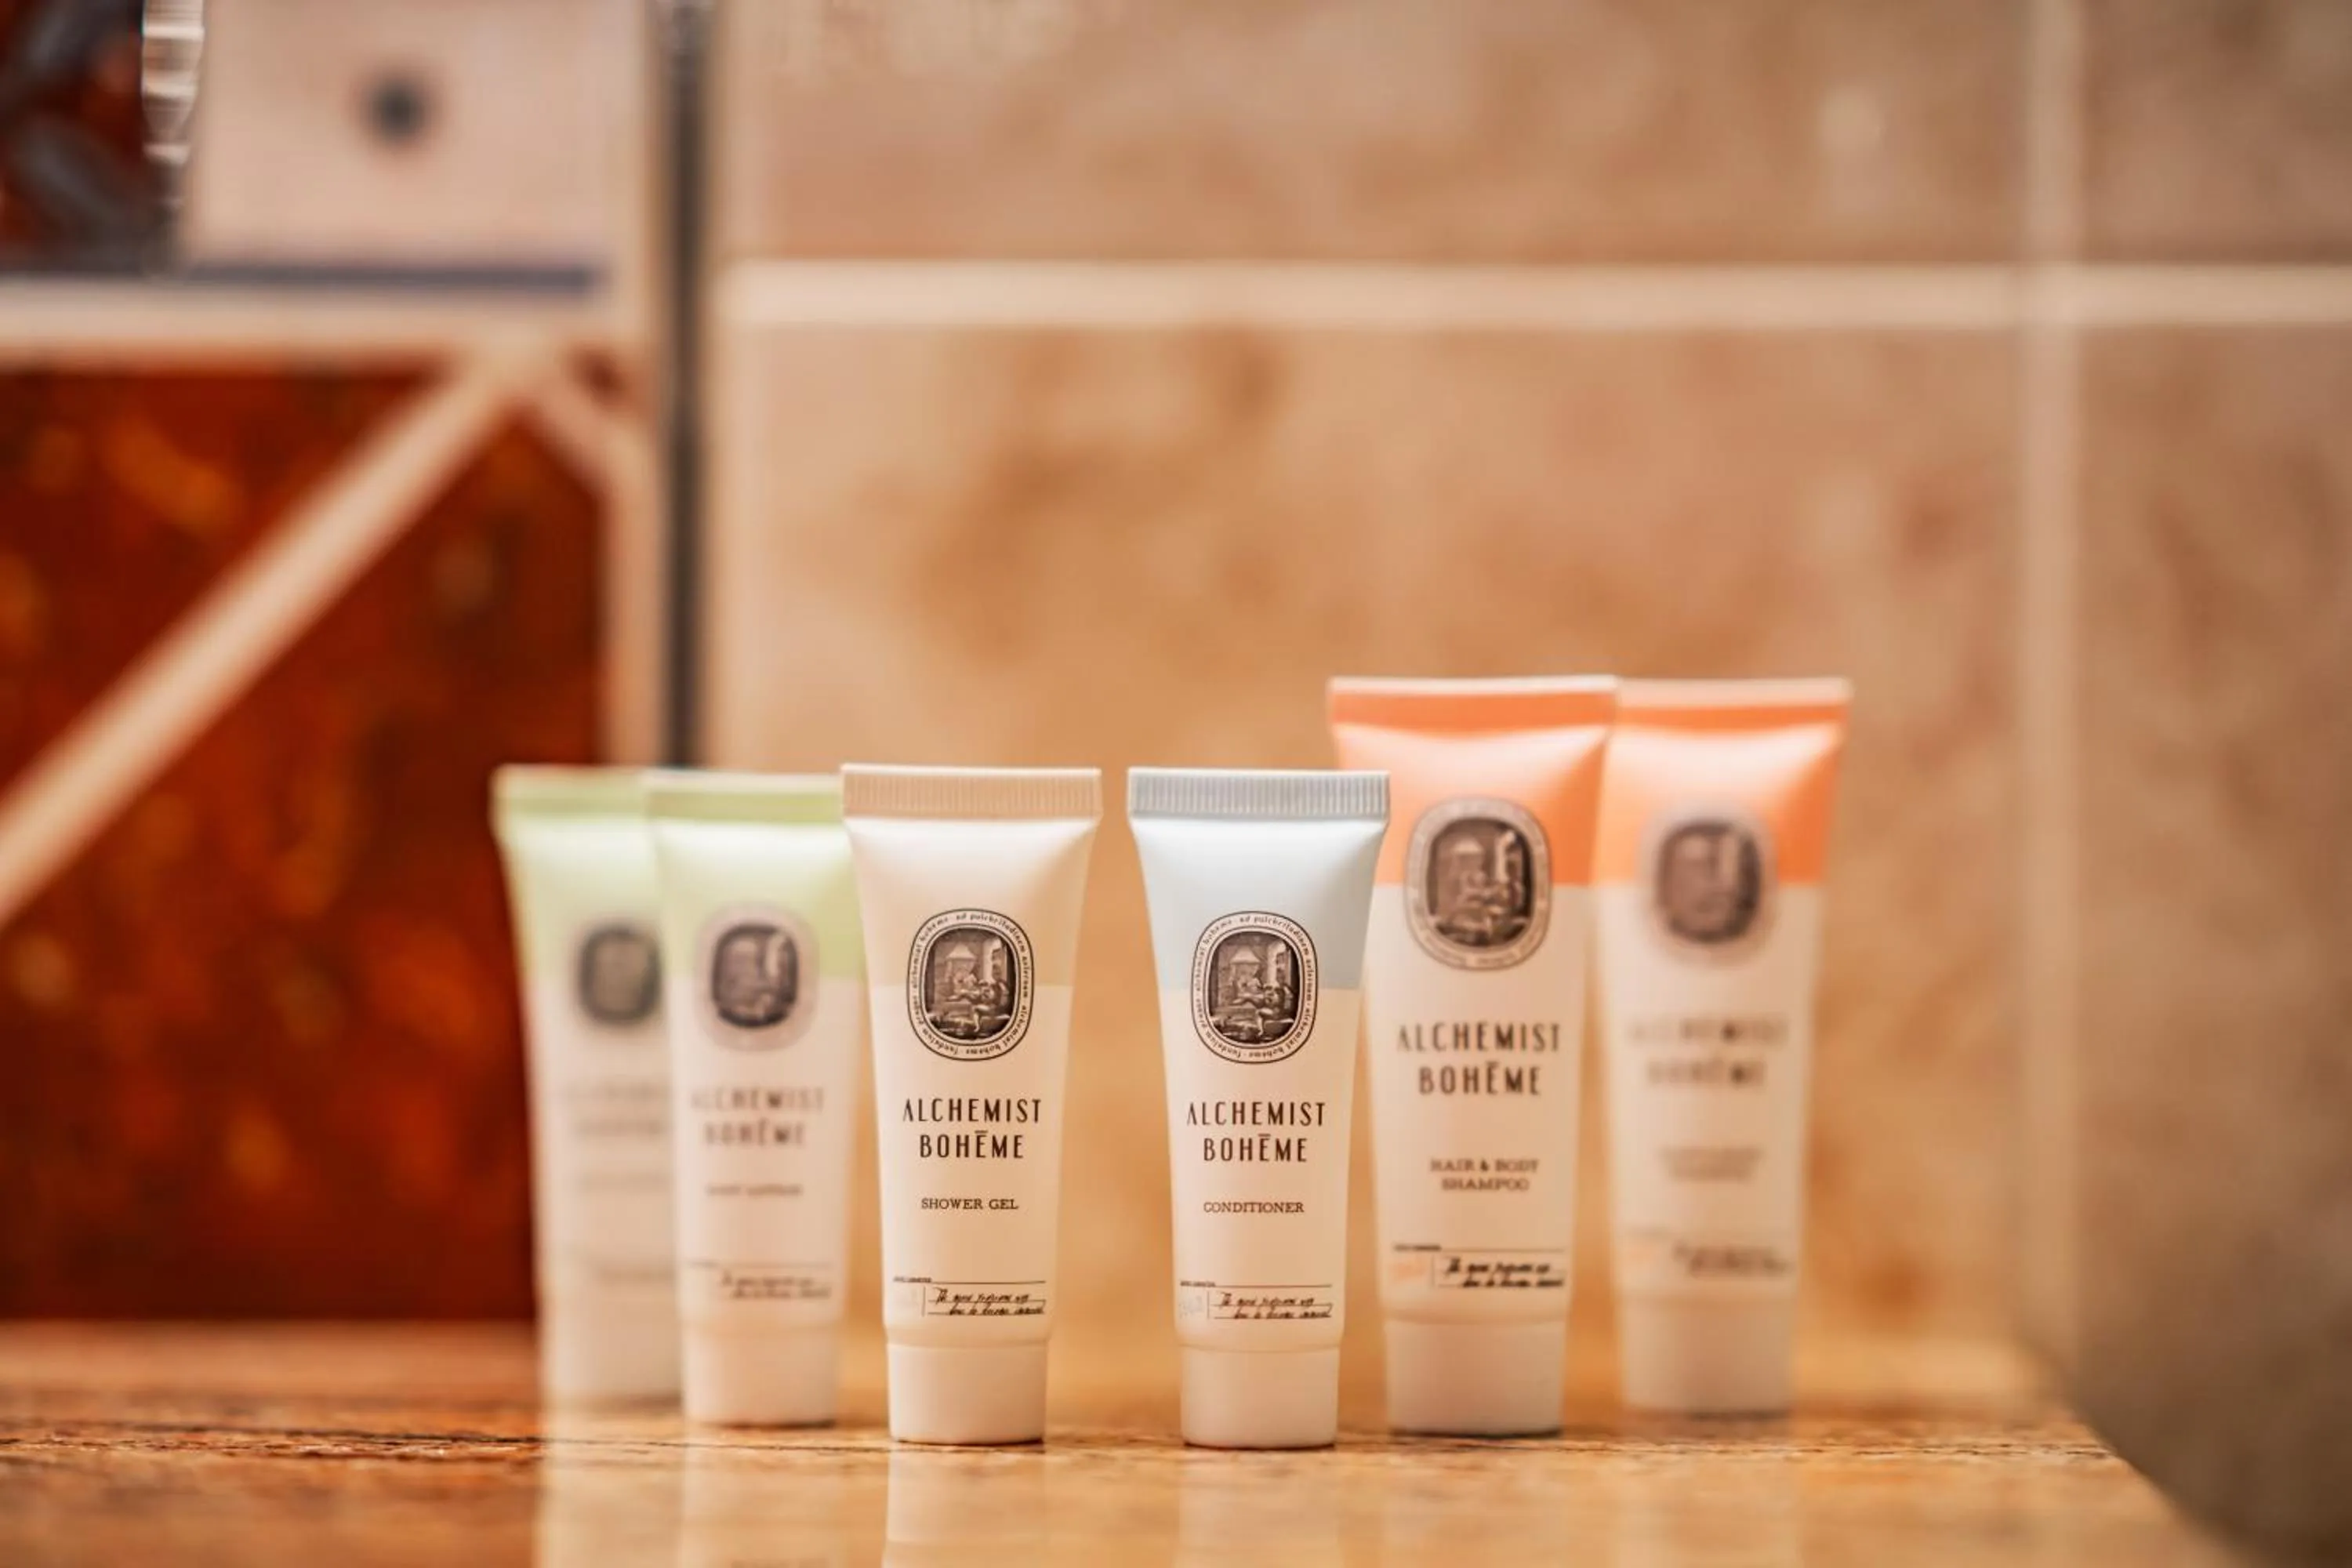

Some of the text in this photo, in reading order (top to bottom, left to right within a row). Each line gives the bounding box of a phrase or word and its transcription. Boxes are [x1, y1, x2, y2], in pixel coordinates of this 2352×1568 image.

[1396, 1022, 1561, 1053] ALCHEMIST
[903, 1098, 1041, 1123] ALCHEMIST
[1186, 1102, 1326, 1127] ALCHEMIST
[1430, 1159, 1475, 1172] HAIR
[1441, 1178, 1530, 1191] SHAMPOO
[921, 1198, 1019, 1210] SHOWER GEL
[1203, 1202, 1305, 1214] CONDITIONER
